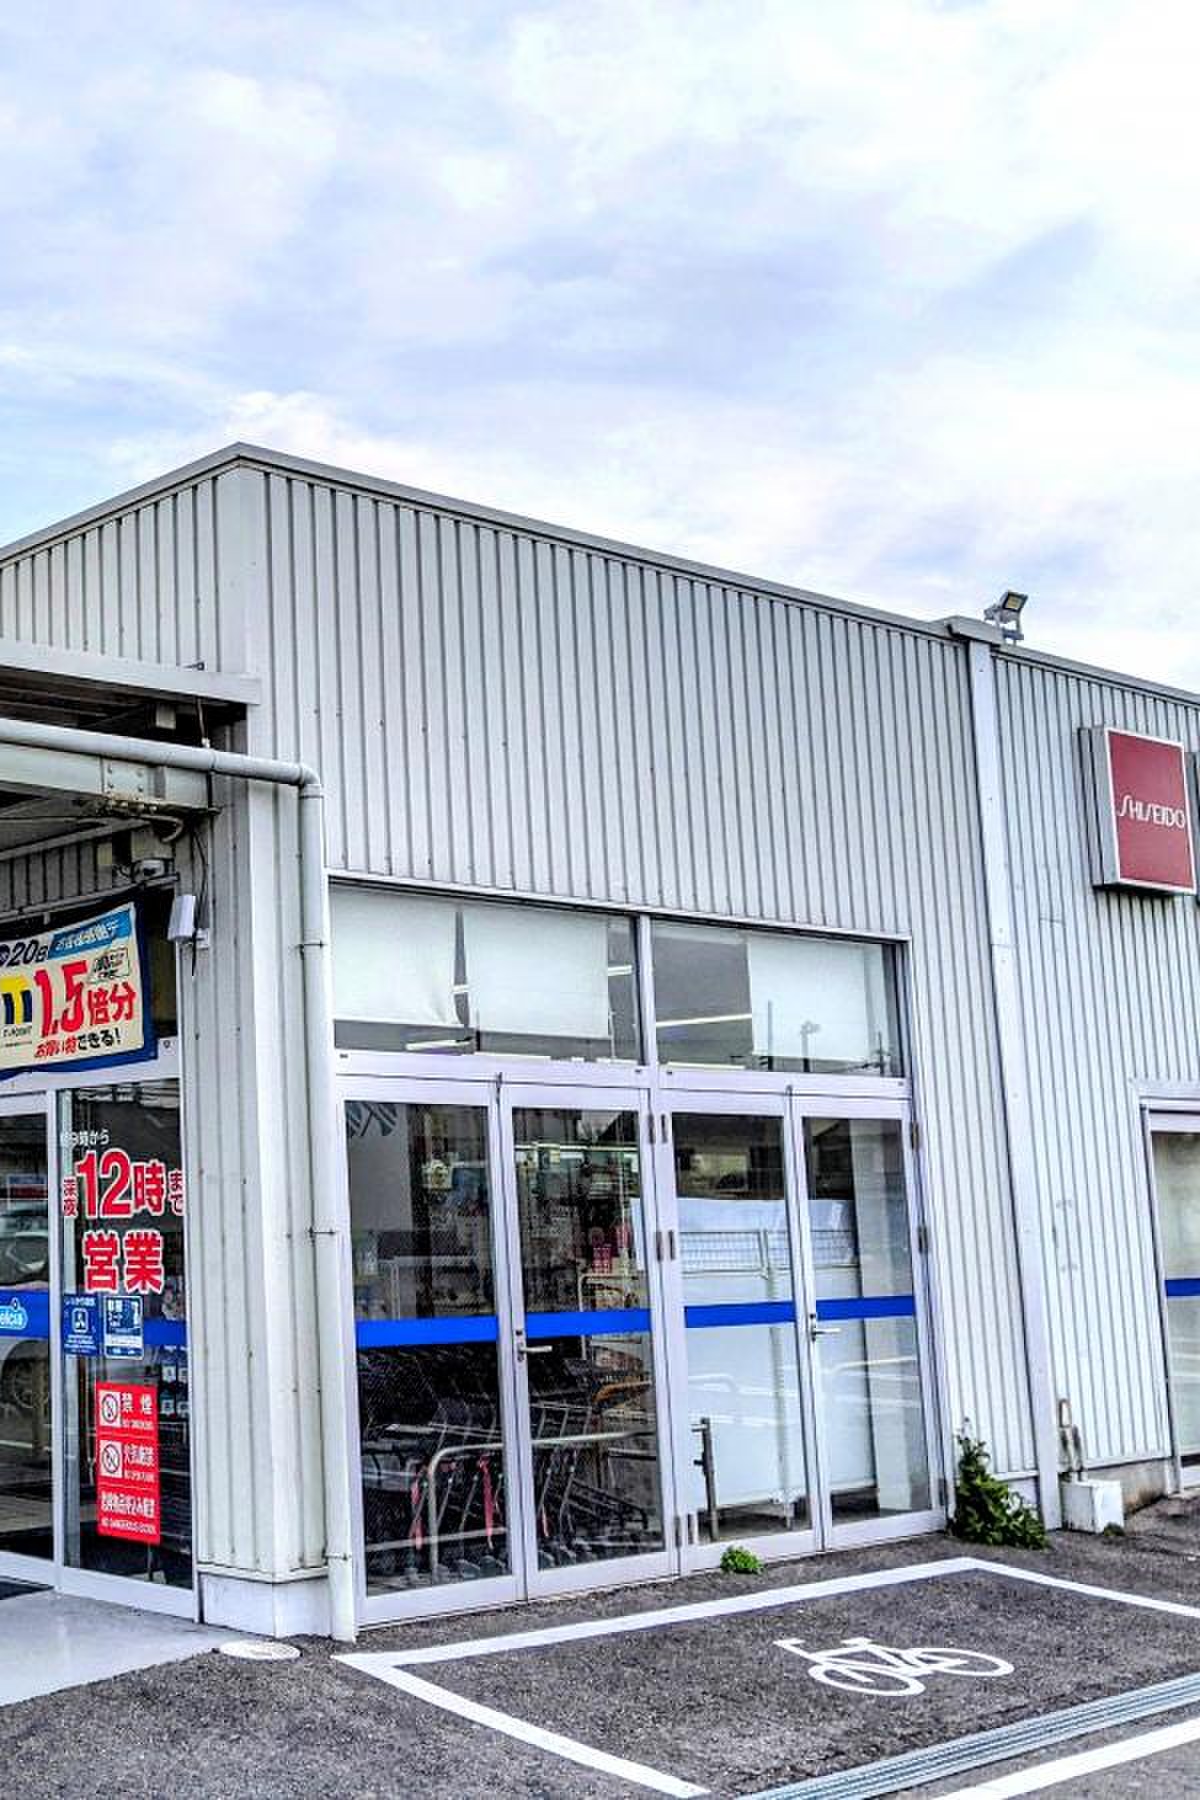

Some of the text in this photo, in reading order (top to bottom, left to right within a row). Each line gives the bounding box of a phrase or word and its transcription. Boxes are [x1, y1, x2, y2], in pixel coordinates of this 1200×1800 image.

[1118, 794, 1187, 829] SHISEIDO
[75, 1149, 166, 1218] 12時
[82, 1230, 164, 1295] 営業
